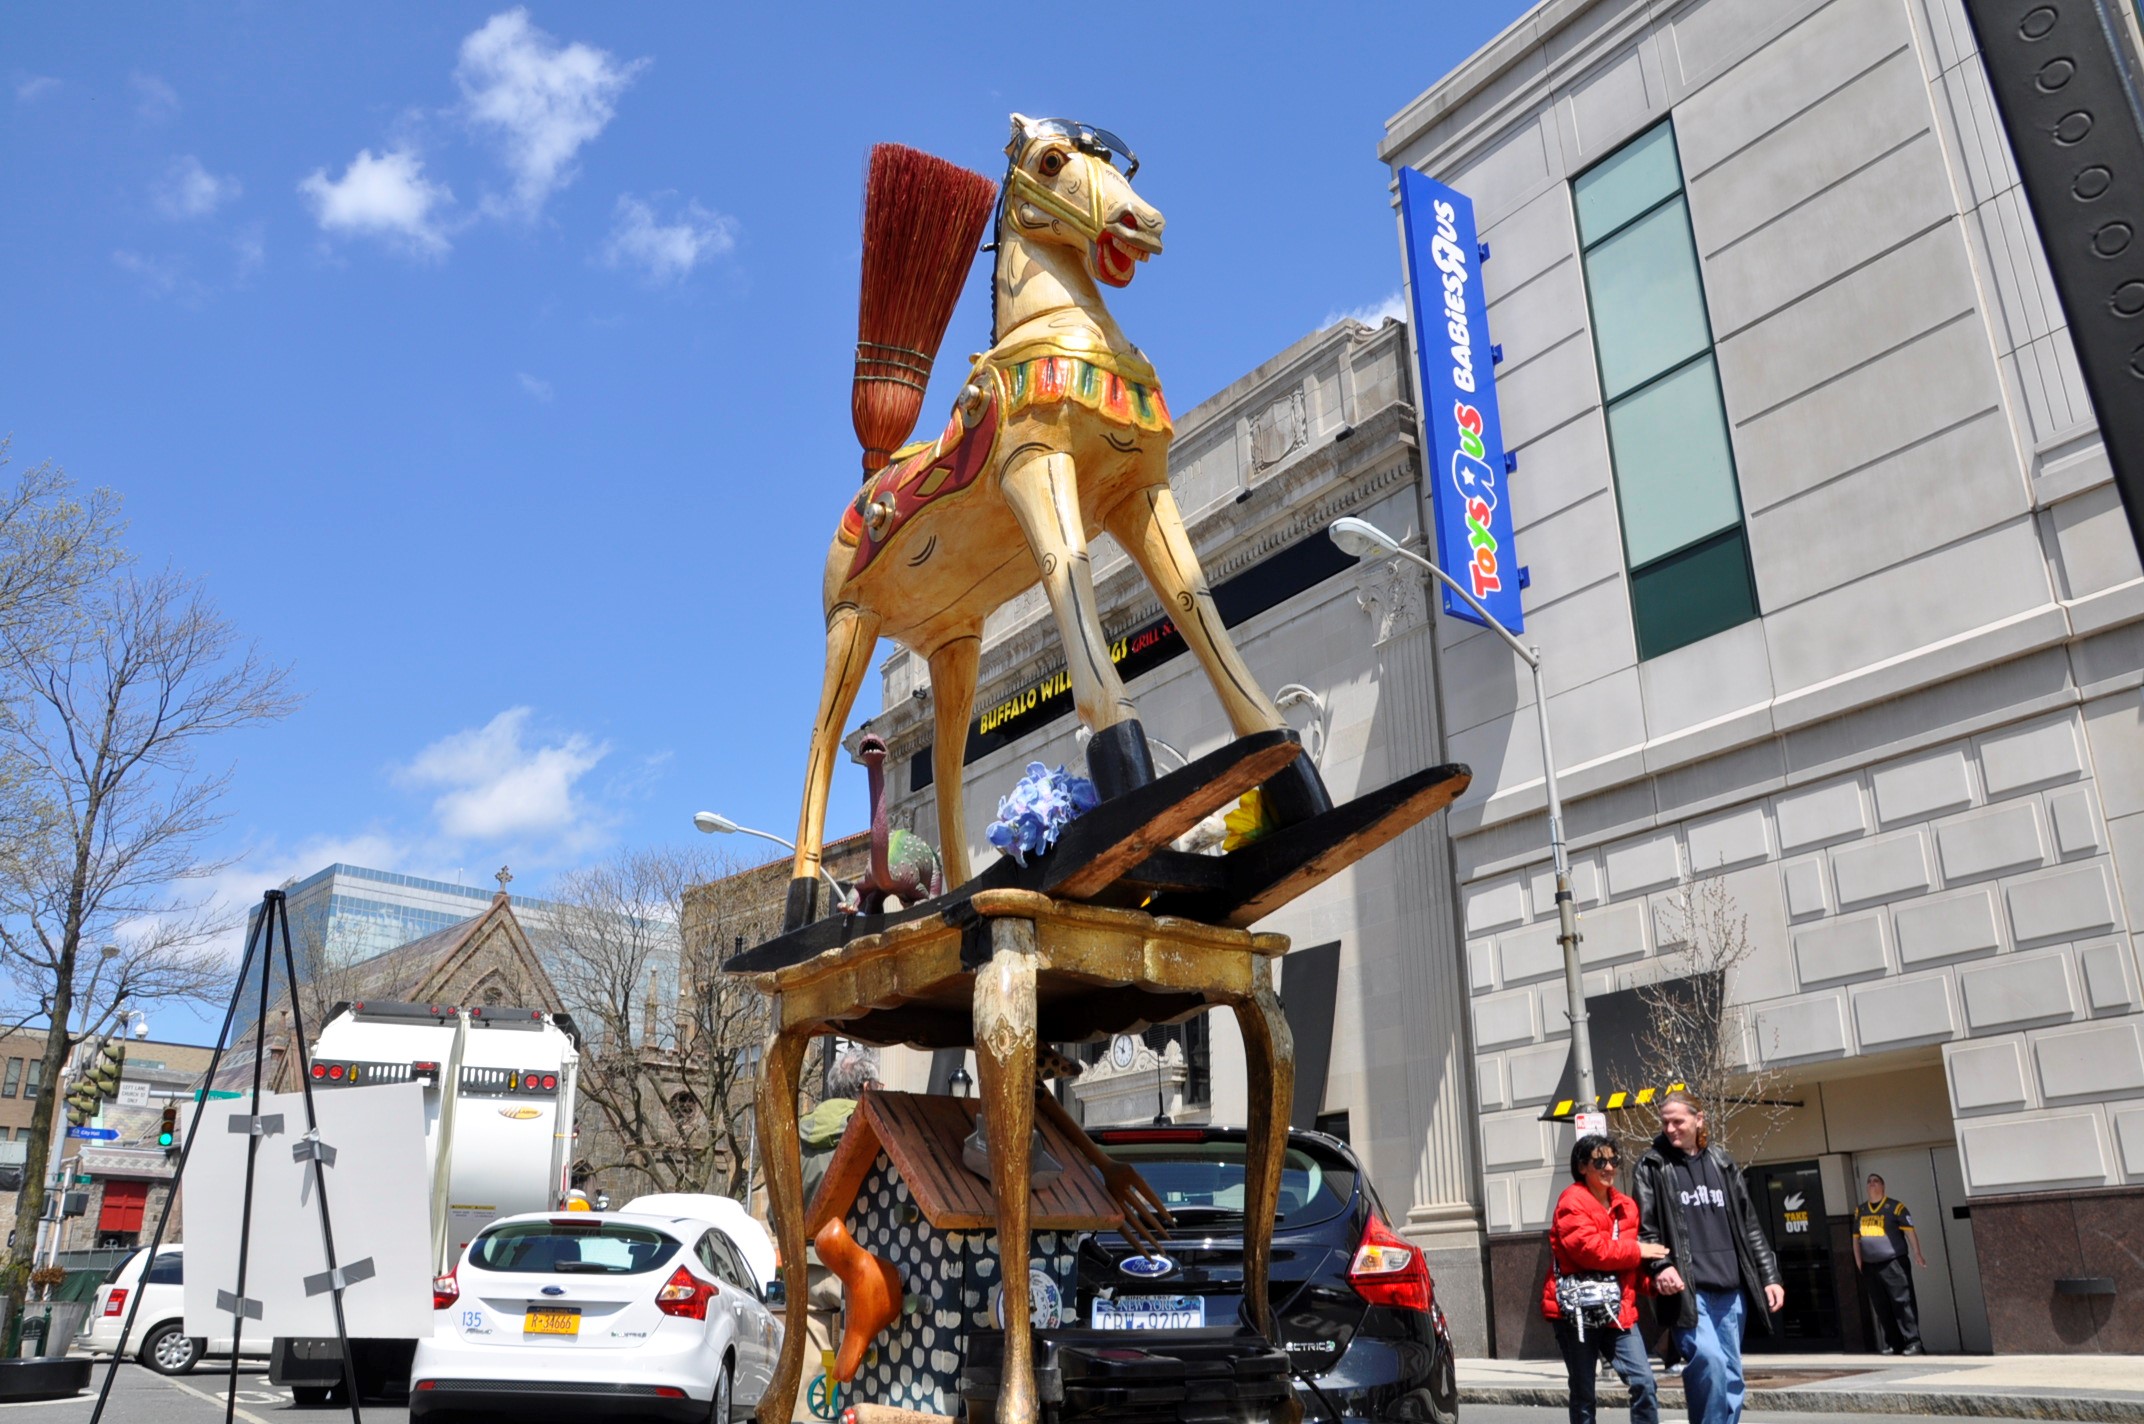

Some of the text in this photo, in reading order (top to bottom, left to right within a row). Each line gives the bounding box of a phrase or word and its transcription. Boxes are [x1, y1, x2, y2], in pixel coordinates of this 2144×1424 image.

[1131, 627, 1160, 654] GRILL
[980, 688, 1037, 735] BUFFALO
[80, 1129, 90, 1137] City
[1784, 1211, 1808, 1221] TAKE
[1785, 1221, 1809, 1233] OUT
[1132, 1259, 1160, 1271] Ford
[1120, 1300, 1177, 1311] NEW YORK
[462, 1311, 482, 1328] 135
